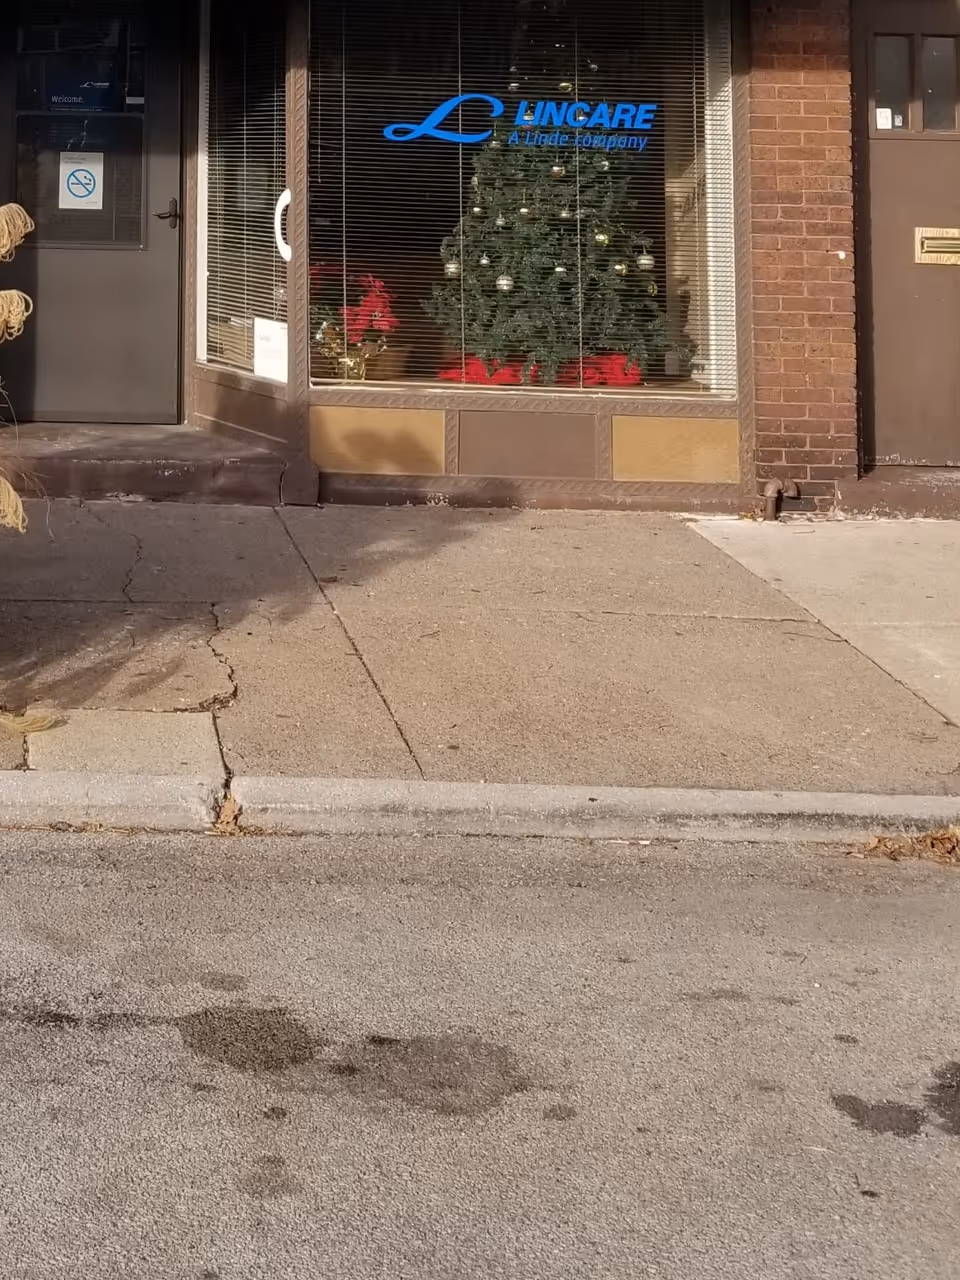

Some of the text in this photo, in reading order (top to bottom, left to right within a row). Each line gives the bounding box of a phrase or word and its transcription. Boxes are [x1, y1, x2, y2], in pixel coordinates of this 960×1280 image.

[514, 100, 657, 129] LINCARE
[508, 131, 648, 152] A Linde company
